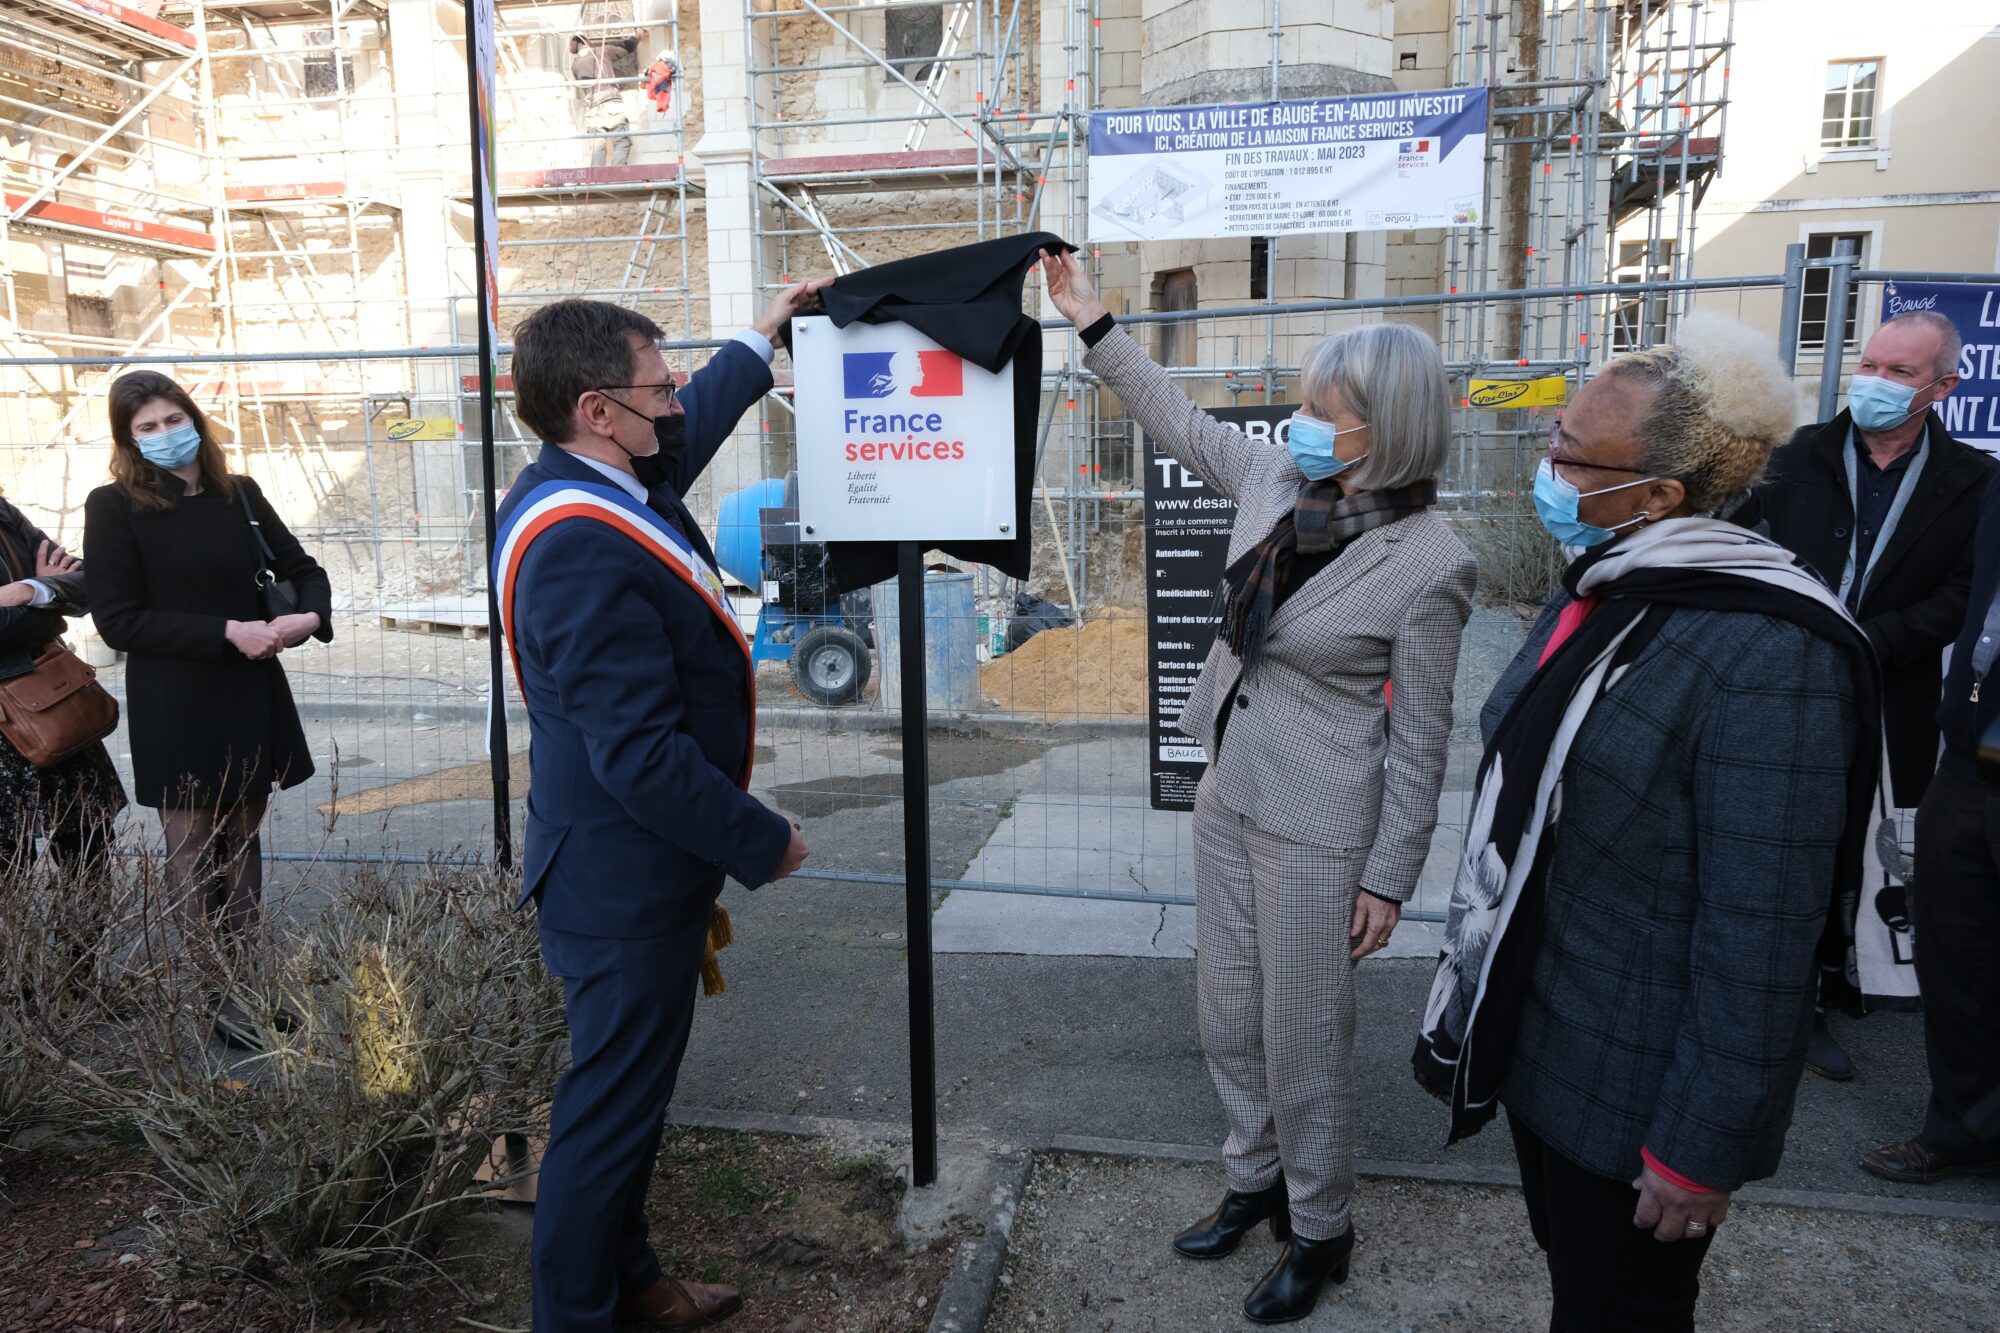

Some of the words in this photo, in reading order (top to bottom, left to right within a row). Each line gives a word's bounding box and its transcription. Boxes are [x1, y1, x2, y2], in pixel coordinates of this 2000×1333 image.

[1106, 114, 1142, 135] POUR
[1145, 112, 1185, 134] VOUS,
[1189, 111, 1206, 131] LA
[1209, 108, 1247, 130] VILLE
[1250, 107, 1269, 128] DE
[1273, 100, 1397, 126] BAUGÉ-EN-ANJOU
[1399, 94, 1466, 118] INVESTIT
[1154, 134, 1172, 152] ICI,
[1174, 131, 1228, 150] CRÉATION
[1230, 130, 1246, 147] DE
[1248, 128, 1263, 146] LA
[1265, 126, 1308, 145] MAISON
[1311, 123, 1356, 141] FRANCE
[1358, 120, 1414, 139] SERVICES
[1225, 153, 1241, 166] FIN
[1243, 151, 1262, 165] DES
[1264, 149, 1309, 163] TRAVAUX
[1317, 147, 1336, 161] MAI
[1339, 145, 1366, 160] 2023
[1398, 161, 1429, 169] services
[1240, 170, 1248, 179] DE
[844, 408, 943, 434] France
[845, 434, 965, 462] services
[847, 471, 877, 481] Liberté
[847, 482, 878, 494] Égalité
[847, 494, 891, 504] Fraternité
[1155, 518, 1161, 526] 2
[1176, 518, 1186, 526] du
[1187, 518, 1228, 526] commerce
[1155, 528, 1179, 536] Inscrit
[1180, 528, 1185, 536] à
[1186, 528, 1212, 536] l'Ordre
[1155, 549, 1200, 558] Autorisation
[1157, 615, 1181, 624] Nature
[1181, 615, 1196, 624] des
[1157, 641, 1183, 650] Délivré
[1183, 641, 1191, 650] le
[1158, 661, 1186, 670] Surface
[1186, 661, 1196, 670] de
[1158, 675, 1186, 684] Hauteur
[1158, 697, 1186, 706] Surface
[1159, 735, 1168, 744] Le
[1168, 735, 1195, 744] dossier
